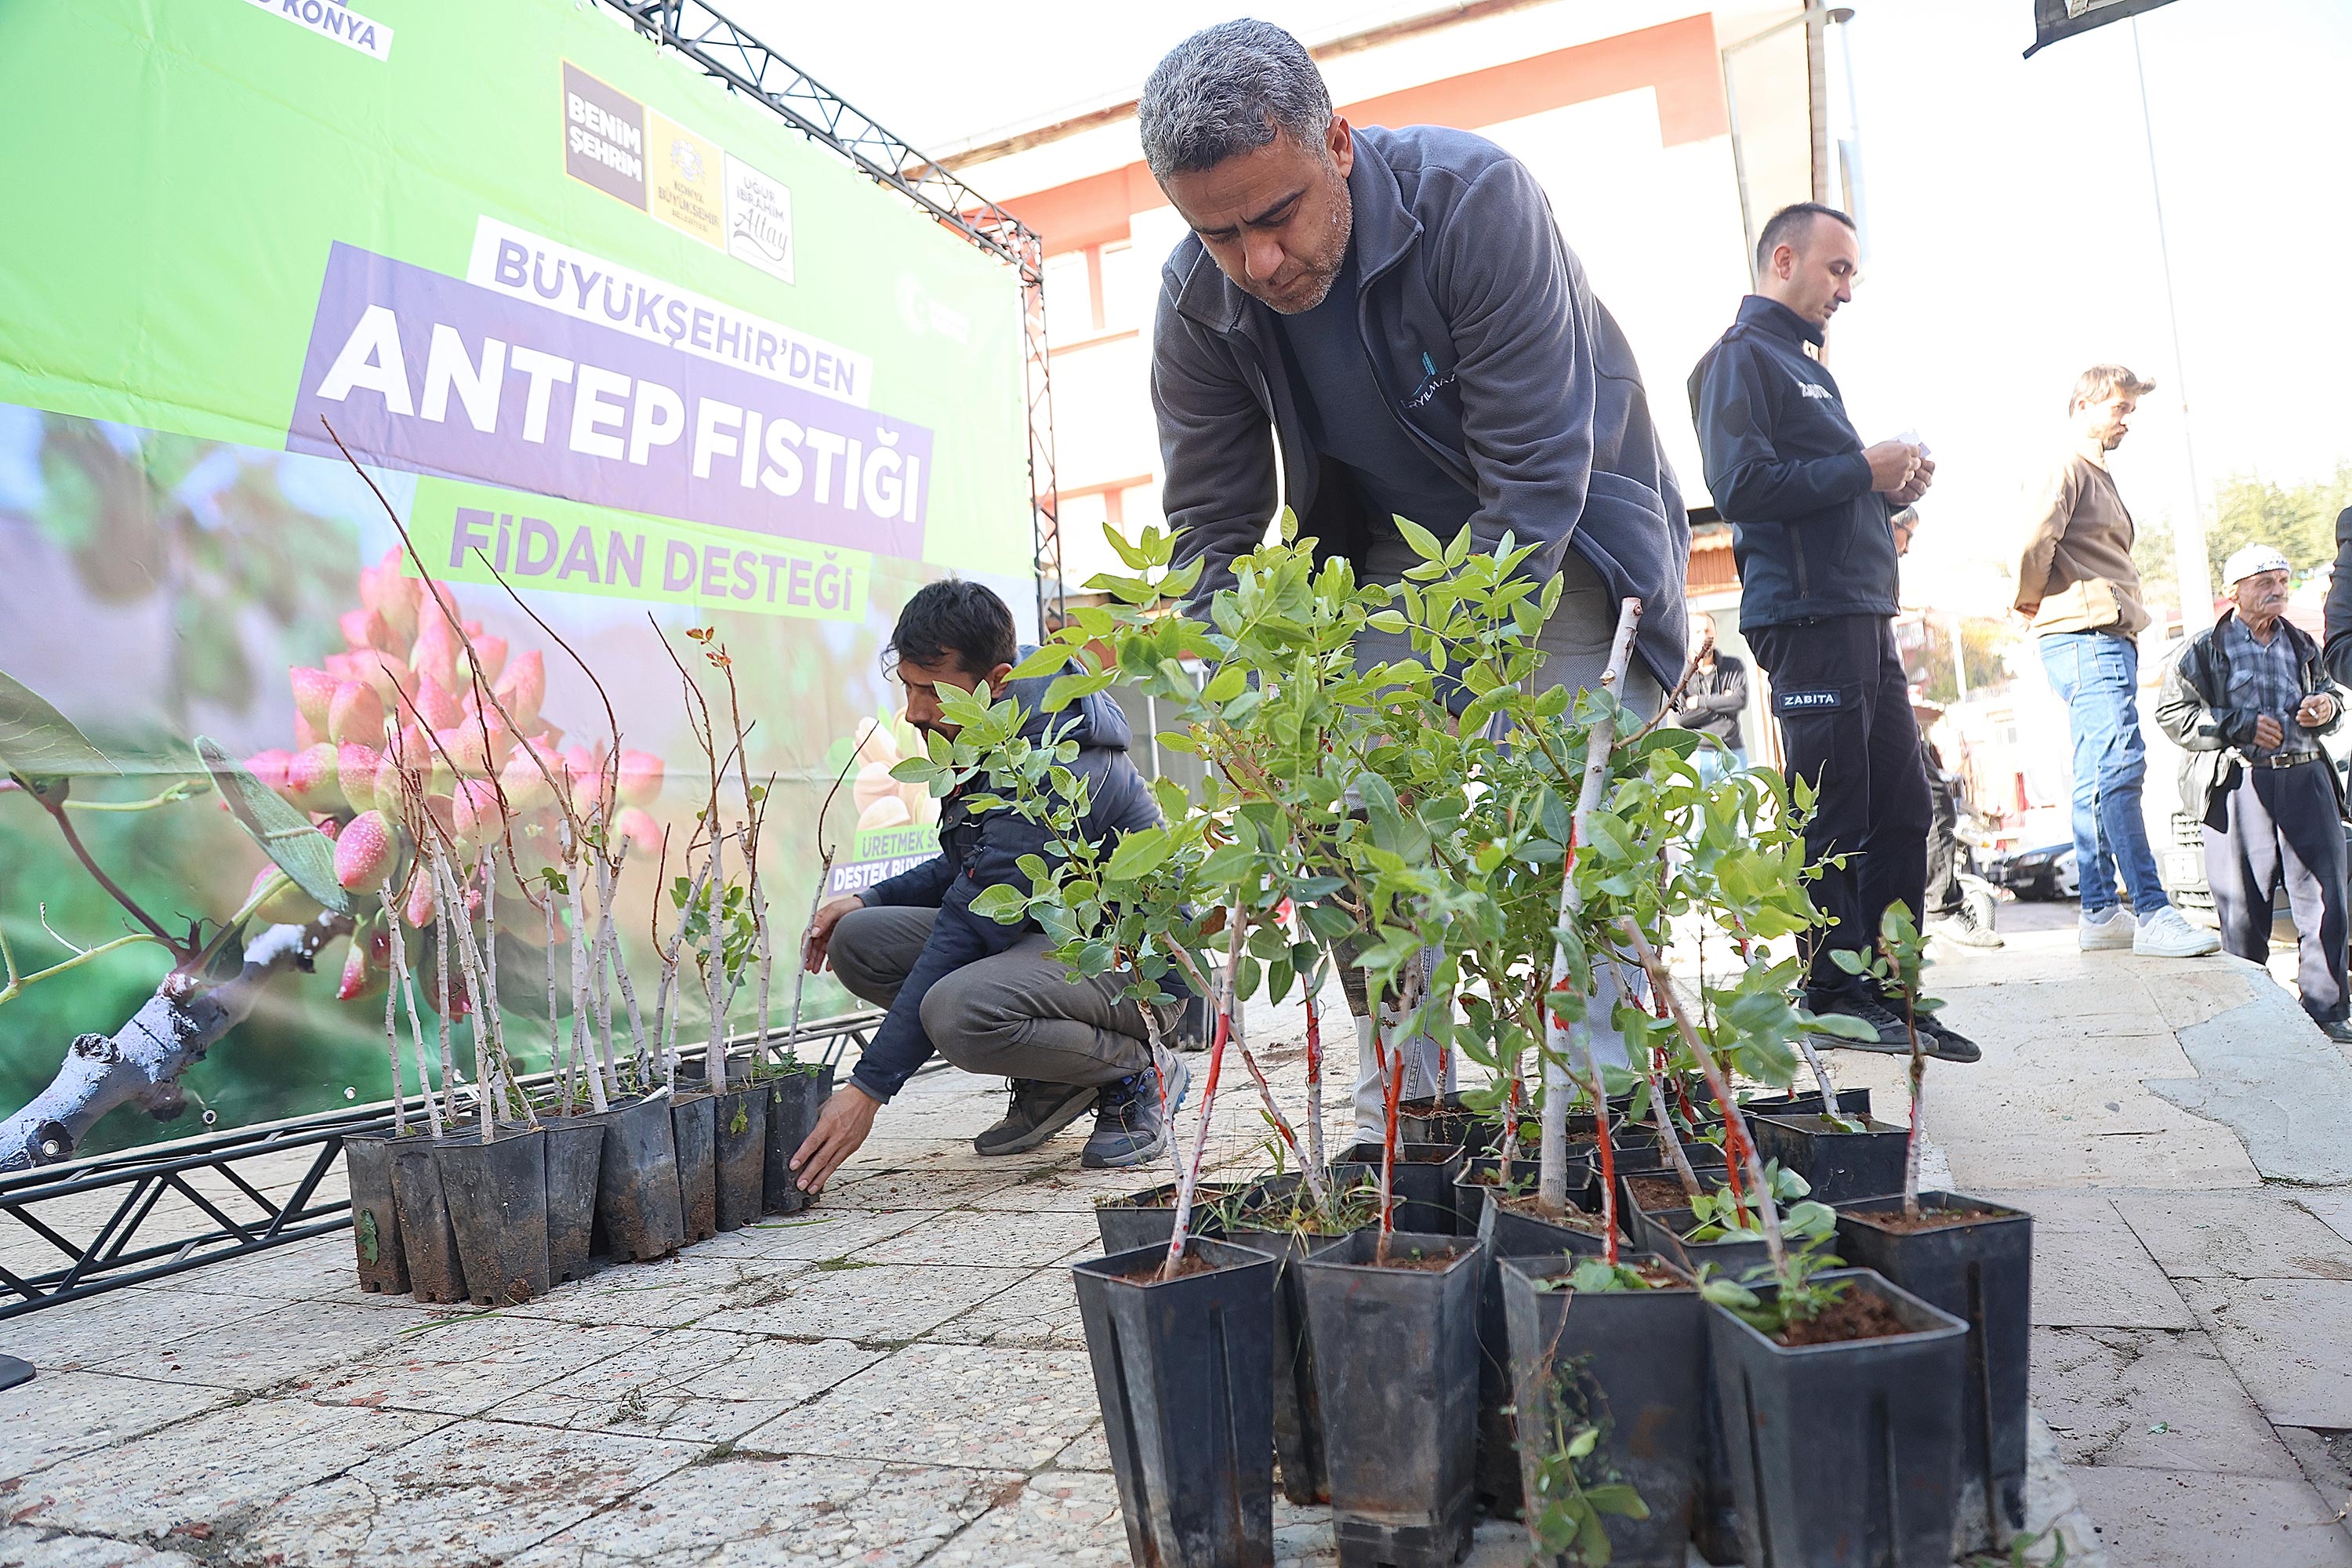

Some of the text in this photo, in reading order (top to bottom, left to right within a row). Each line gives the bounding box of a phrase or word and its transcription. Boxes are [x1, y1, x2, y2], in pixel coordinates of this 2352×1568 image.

[282, 0, 376, 51] KONYA
[568, 91, 641, 154] BENİM
[569, 125, 643, 182] ŞEHRİM
[448, 506, 854, 612] FİDAN DESTEĞİ
[1784, 694, 1835, 706] ZABITA
[833, 861, 891, 892] DESTEK
